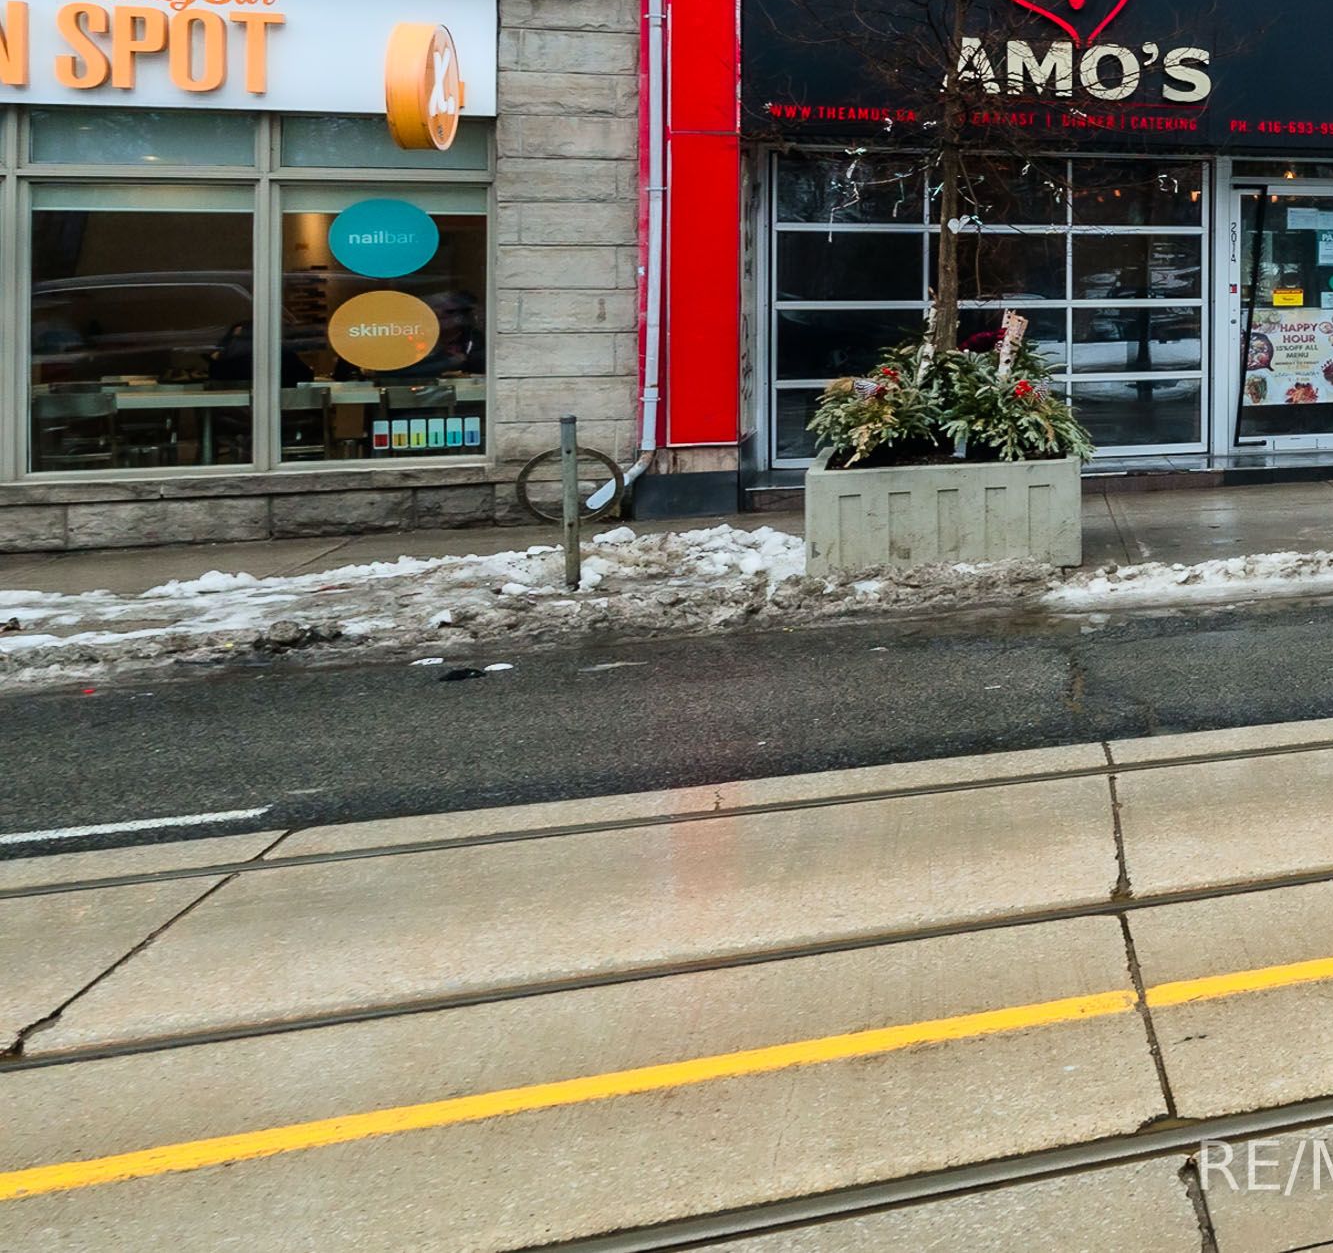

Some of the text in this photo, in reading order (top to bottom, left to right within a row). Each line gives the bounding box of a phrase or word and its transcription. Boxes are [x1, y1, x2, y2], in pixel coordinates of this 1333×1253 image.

[55, 2, 286, 95] SPOT
[940, 36, 1212, 102] AMO'S
[1130, 117, 1198, 132] CATERING
[1280, 323, 1318, 333] HAPPY
[1283, 334, 1316, 344] HOUR
